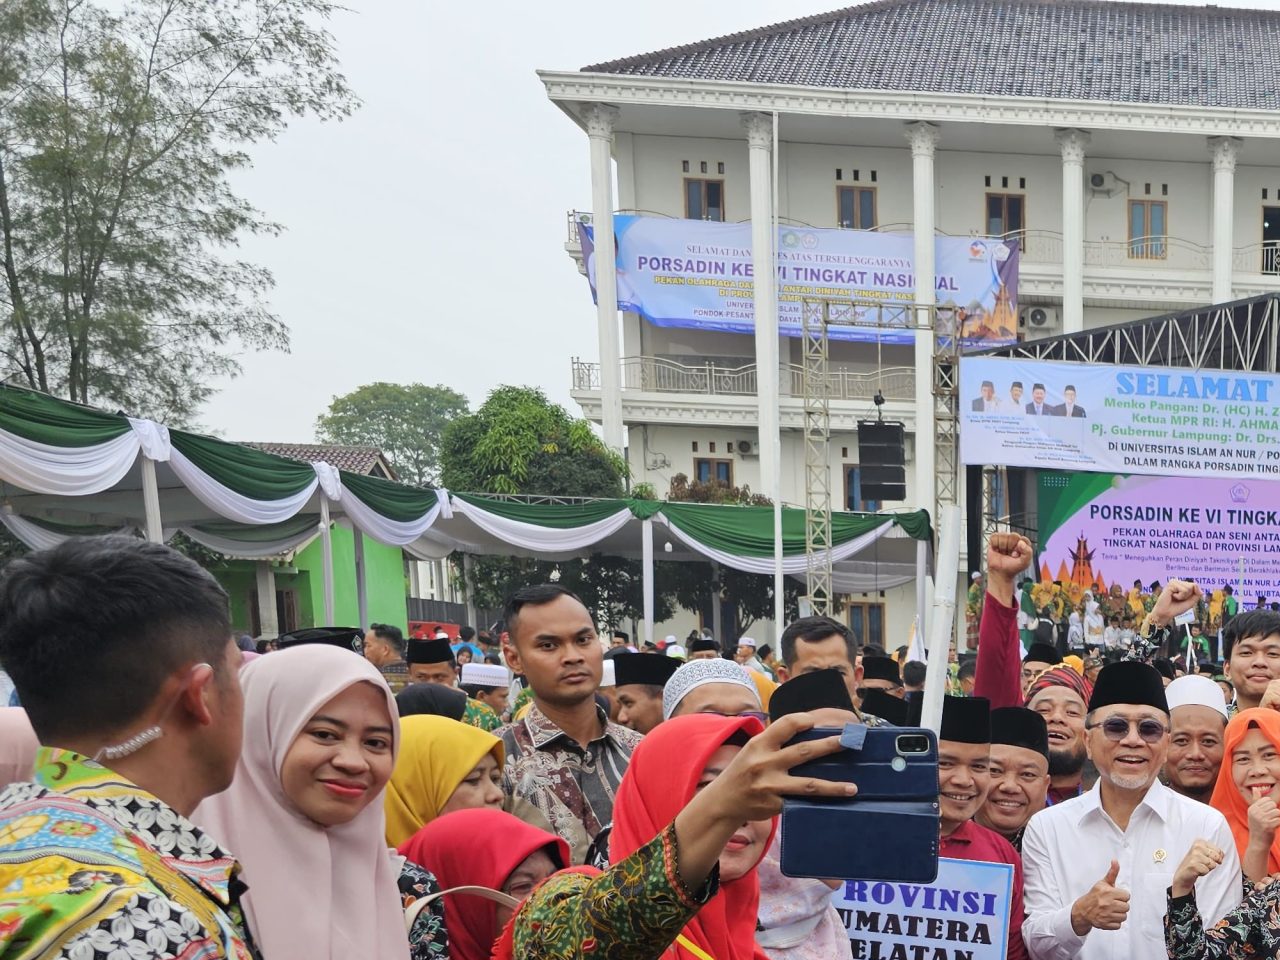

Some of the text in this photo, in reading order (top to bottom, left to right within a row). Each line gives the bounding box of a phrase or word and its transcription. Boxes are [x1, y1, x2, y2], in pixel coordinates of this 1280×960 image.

[686, 245, 730, 257] SELAMAT
[791, 252, 812, 262] ATAS
[815, 254, 911, 268] TERSELENGGARANYA
[638, 256, 725, 275] PORSADIN
[731, 262, 754, 277] KE
[793, 267, 867, 285] TINGKAT
[873, 272, 959, 291] NASIAL
[655, 276, 685, 286] PEKAN
[687, 278, 735, 288] OLAHRAGA
[783, 285, 813, 294] ANTAR
[855, 289, 893, 299] TINGKAT
[719, 288, 729, 297] DI
[693, 310, 723, 318] PONDOK
[1116, 372, 1274, 402] SELAMAT
[1104, 398, 1146, 409] Menko
[1151, 401, 1198, 413] Pangan:
[1203, 403, 1219, 413] Dr.
[1224, 404, 1250, 417] (HC)
[1255, 406, 1268, 416] H.
[1132, 413, 1167, 424] Ketua
[1171, 415, 1198, 426] MPR
[1203, 417, 1219, 427] RI:
[1222, 418, 1235, 428] H.
[1091, 424, 1107, 437] Pj.
[1111, 425, 1168, 438] Gubernur
[1172, 429, 1232, 443] Lampung:
[1236, 432, 1252, 443] Dr.
[1257, 433, 1280, 444] Drs.
[1108, 442, 1118, 451] Di
[1121, 443, 1184, 455] UNIVERSITAS
[1187, 446, 1217, 457] ISLAM
[1219, 448, 1233, 458] AN
[1236, 449, 1256, 459] NUR
[1124, 457, 1158, 468] DALAM
[1161, 459, 1201, 470] RANGKA
[1204, 461, 1254, 472] PORSADIN
[1090, 504, 1173, 522] PORSADIN
[1179, 507, 1200, 523] KE
[1206, 509, 1220, 524] VI
[1113, 527, 1146, 537] PEKAN
[1149, 528, 1203, 539] OLAHRAGA
[1206, 531, 1225, 540] DAN
[1228, 532, 1251, 541] SENI
[1103, 539, 1146, 549] TINGKAT
[1149, 540, 1199, 550] NASIONAL
[1202, 542, 1212, 551] DI
[1215, 543, 1260, 552] PROVINSI
[1124, 554, 1163, 562] Meneguhkan
[843, 881, 998, 916] ROVINSI
[836, 908, 992, 945] UMATERA
